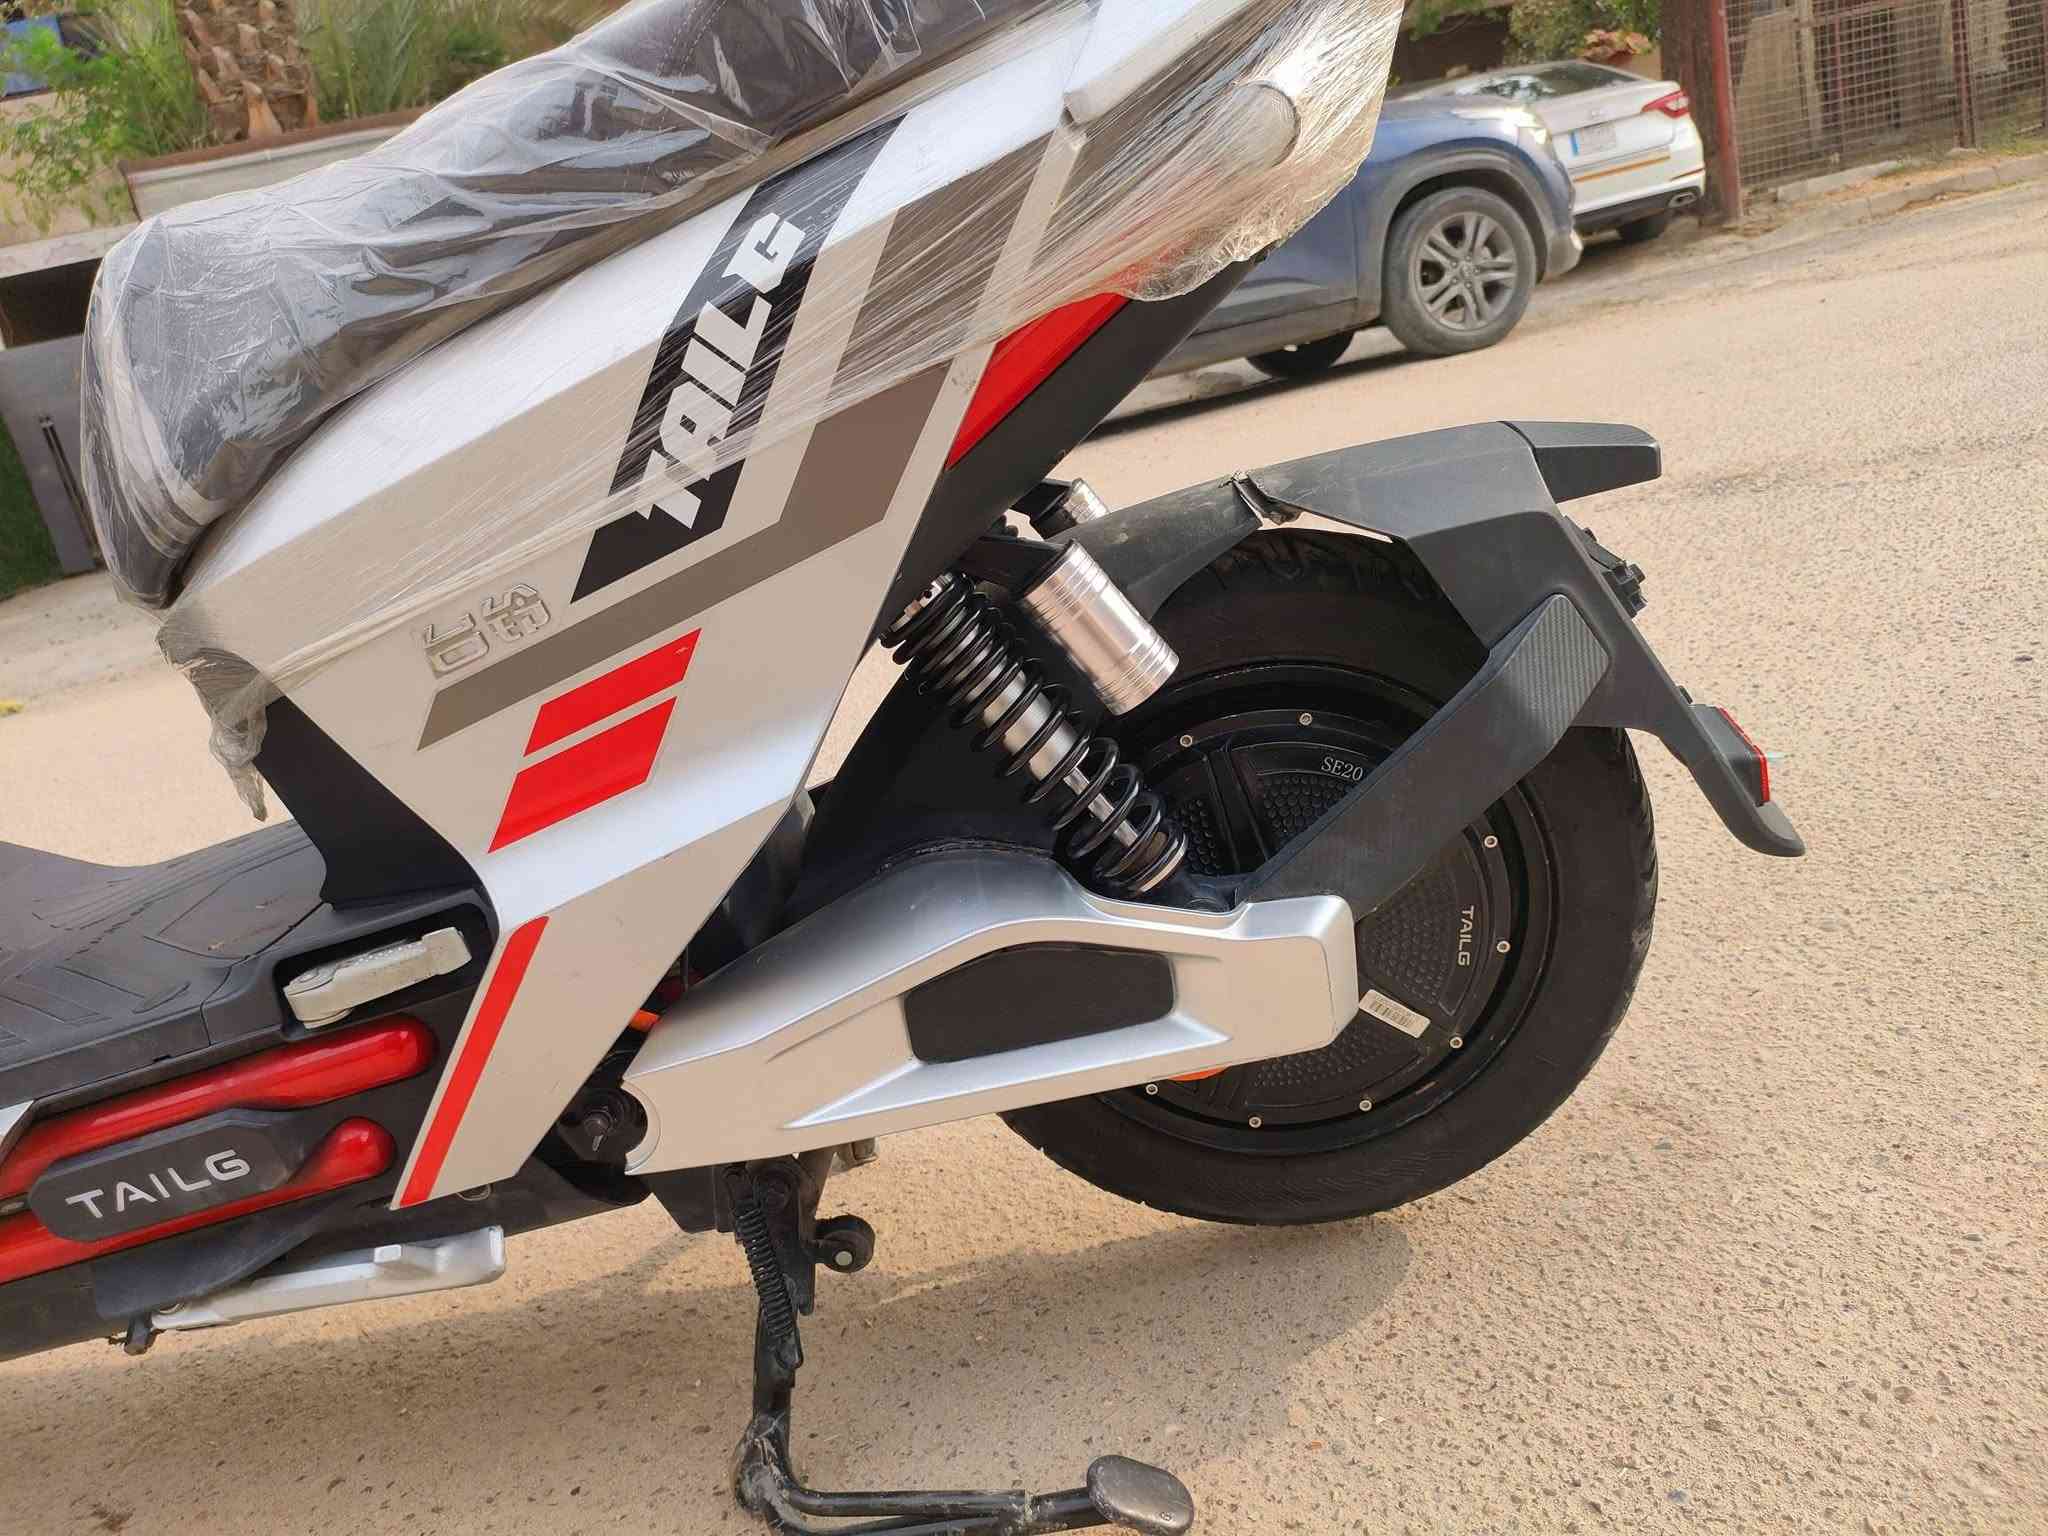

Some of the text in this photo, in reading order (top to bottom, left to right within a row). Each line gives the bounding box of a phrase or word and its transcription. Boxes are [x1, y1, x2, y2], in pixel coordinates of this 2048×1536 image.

[633, 212, 806, 530] TAILG
[1320, 756, 1363, 781] SE20
[1457, 905, 1475, 966] TAILG
[65, 1149, 251, 1218] TAILG
